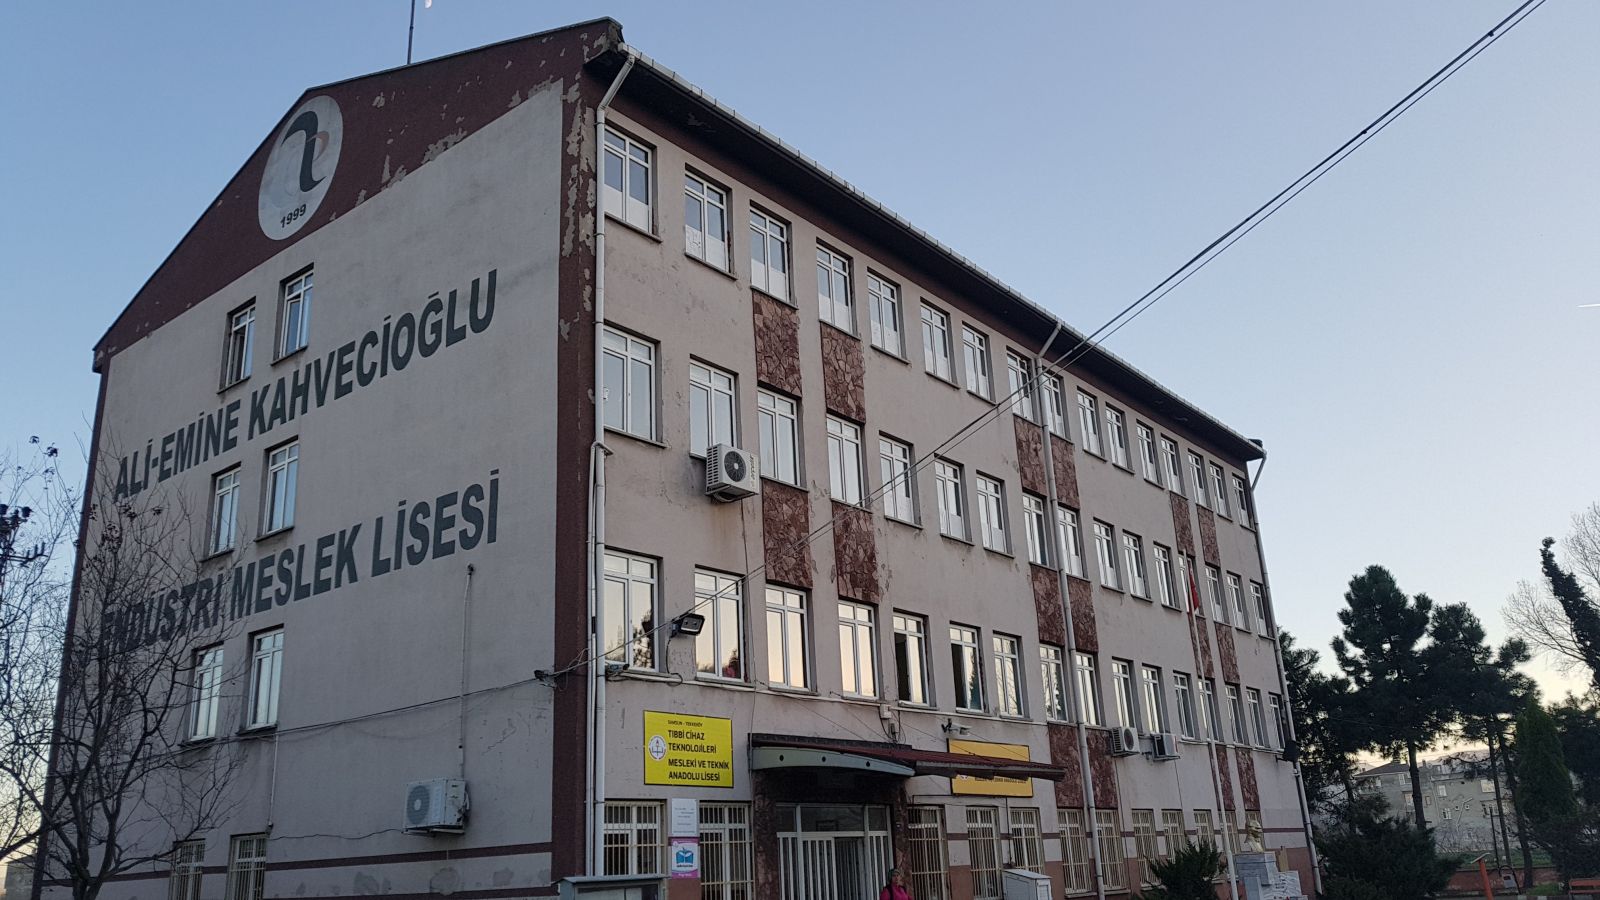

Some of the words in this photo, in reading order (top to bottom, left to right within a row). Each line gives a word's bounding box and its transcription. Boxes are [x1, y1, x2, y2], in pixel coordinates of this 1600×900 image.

[280, 204, 307, 228] 1999
[113, 400, 240, 503] ALİ-EMİNE
[248, 268, 497, 441] KAHVECİOĞLU
[230, 522, 363, 621] MESLEK
[371, 468, 499, 577] LİSESİ
[668, 729, 685, 739] TIBBİ
[685, 730, 705, 740] CİHAZ
[668, 742, 717, 753] TEKNOLOJİLERİ
[668, 758, 696, 767] MESLEKİ
[697, 760, 707, 768] VE
[707, 760, 730, 769] TEKNİK
[668, 771, 700, 780] ANADOLU
[700, 771, 720, 781] LİSESİ
